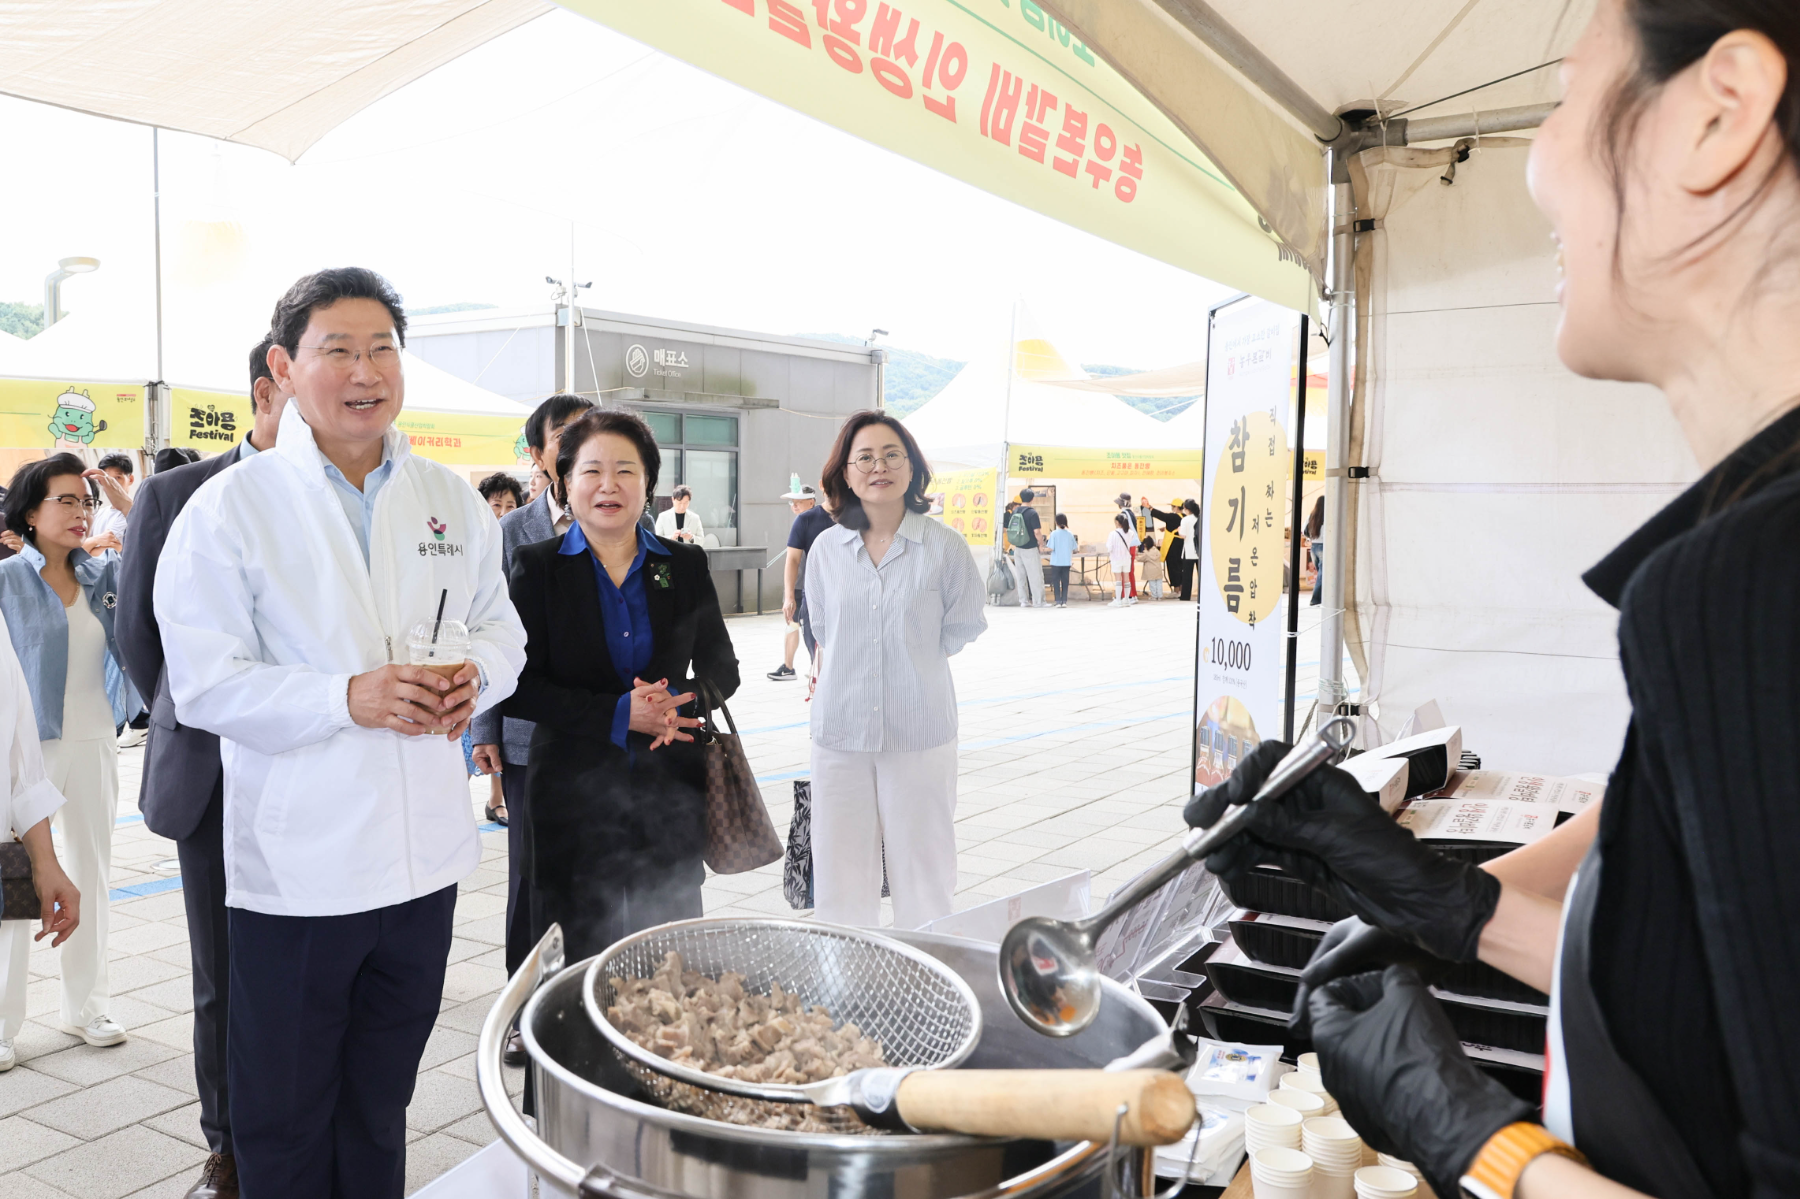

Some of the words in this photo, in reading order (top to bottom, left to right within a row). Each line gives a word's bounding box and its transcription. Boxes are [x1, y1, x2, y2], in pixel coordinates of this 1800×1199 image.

[653, 348, 689, 368] 매표소
[190, 407, 236, 431] 조아용
[189, 430, 235, 443] Festival
[1268, 405, 1277, 456] 직접
[1018, 454, 1044, 466] 조아용
[1018, 465, 1044, 473] Festival
[1223, 415, 1251, 614] 참기름
[1265, 480, 1275, 528] 짜는
[418, 542, 464, 557] 용인특례시
[1211, 636, 1252, 671] 10,000
